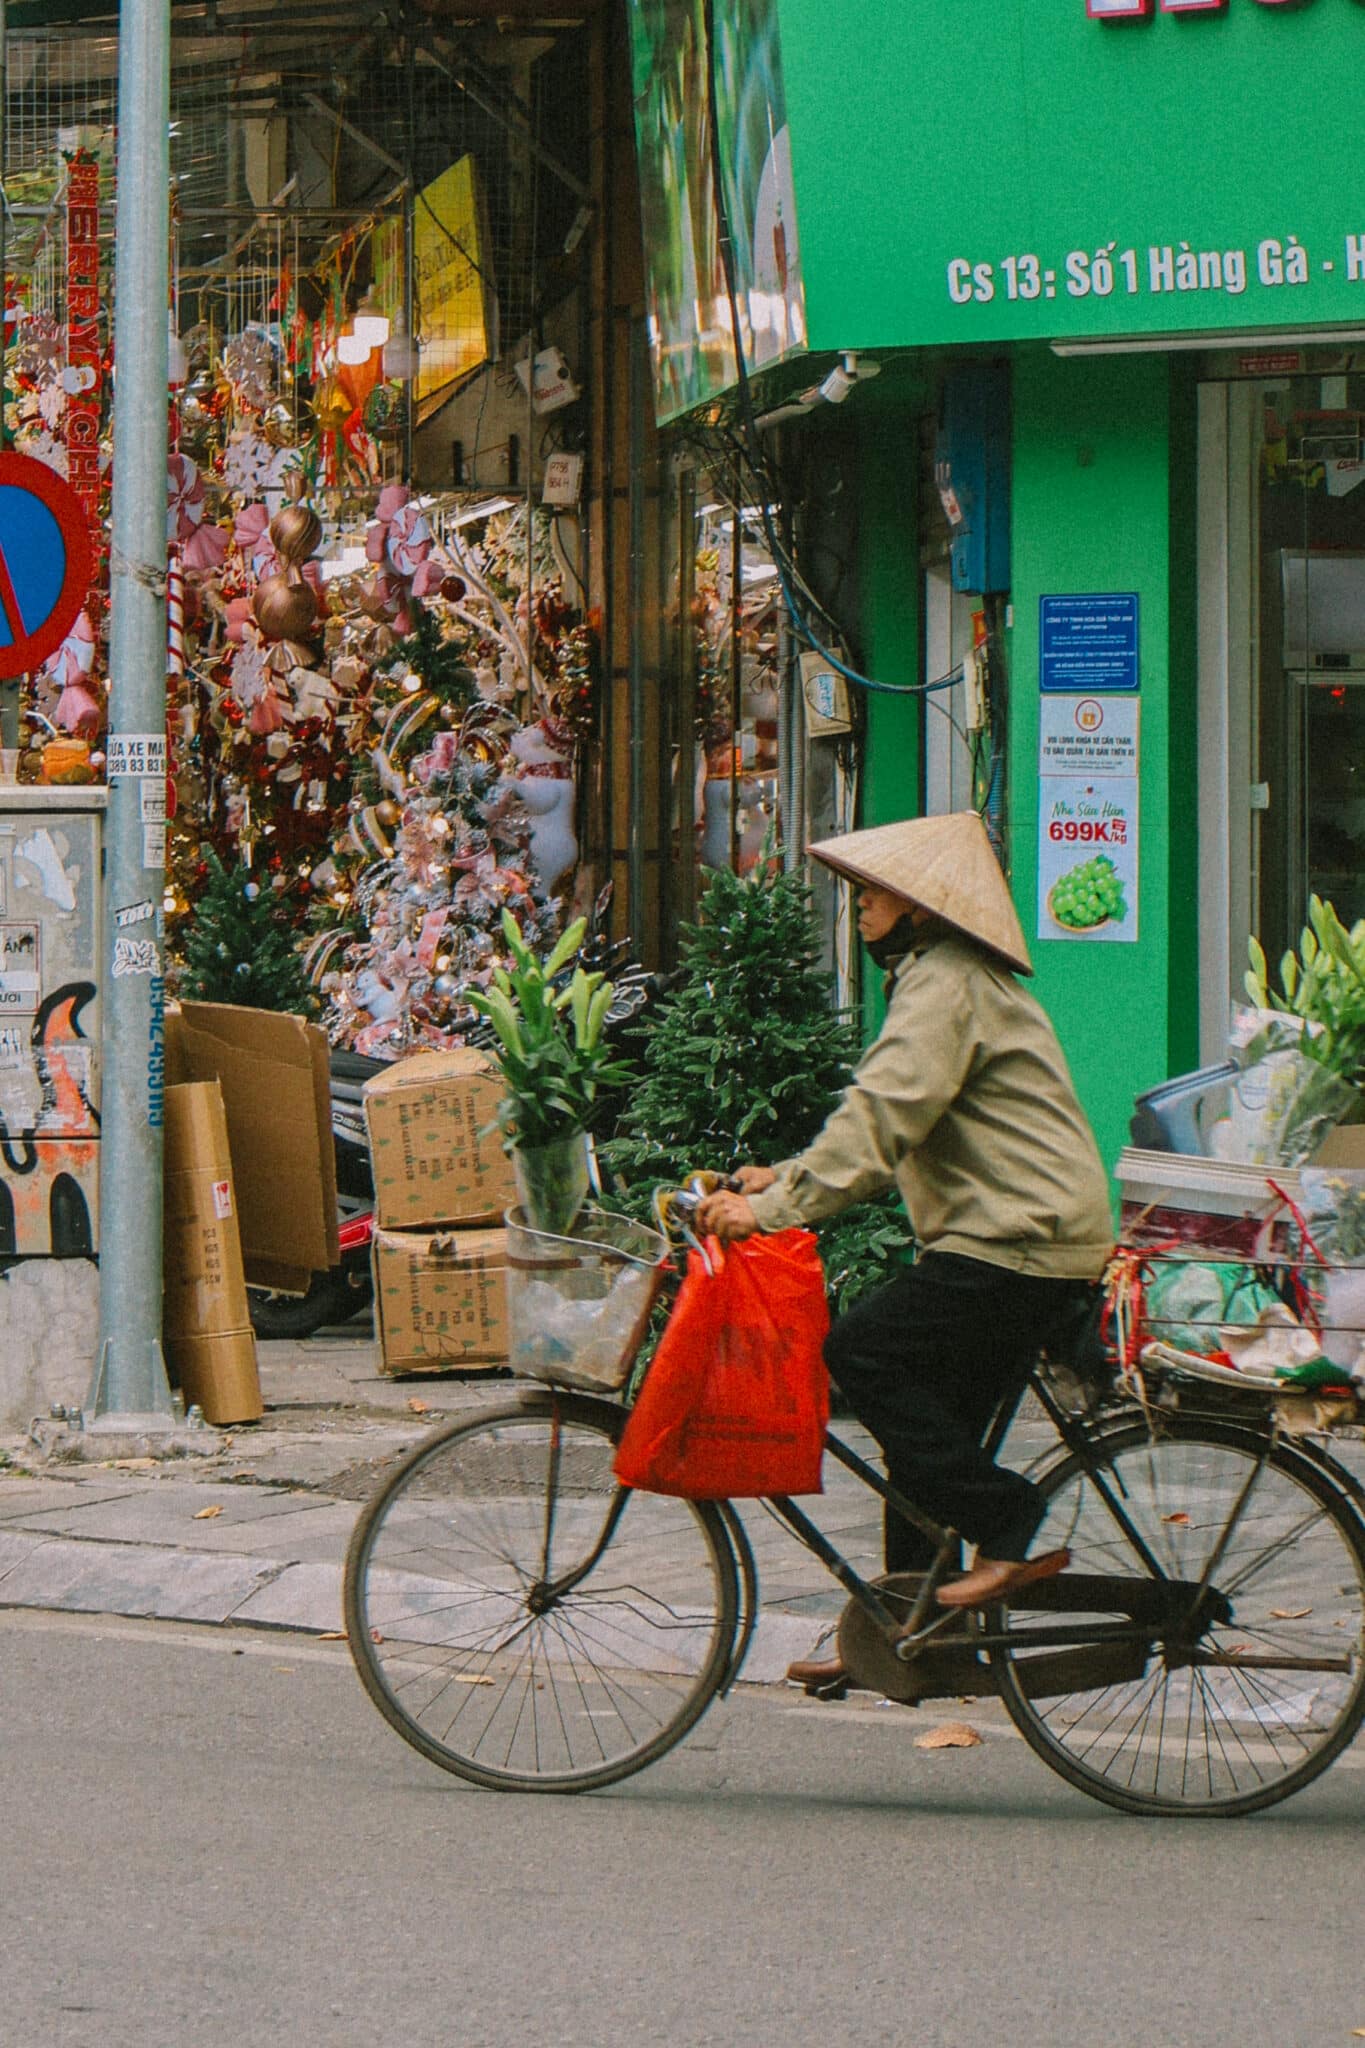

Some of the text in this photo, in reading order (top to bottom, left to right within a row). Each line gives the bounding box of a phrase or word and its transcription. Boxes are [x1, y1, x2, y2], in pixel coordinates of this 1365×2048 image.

[947, 258, 994, 303] Cs
[1001, 254, 1056, 300] 13:
[1065, 241, 1118, 296] Số
[1119, 249, 1139, 293] 1
[1148, 241, 1247, 294] Hàng
[1257, 236, 1309, 286] Gà
[128, 742, 144, 756] XE
[130, 759, 145, 772] 83
[1049, 820, 1110, 842] 699K
